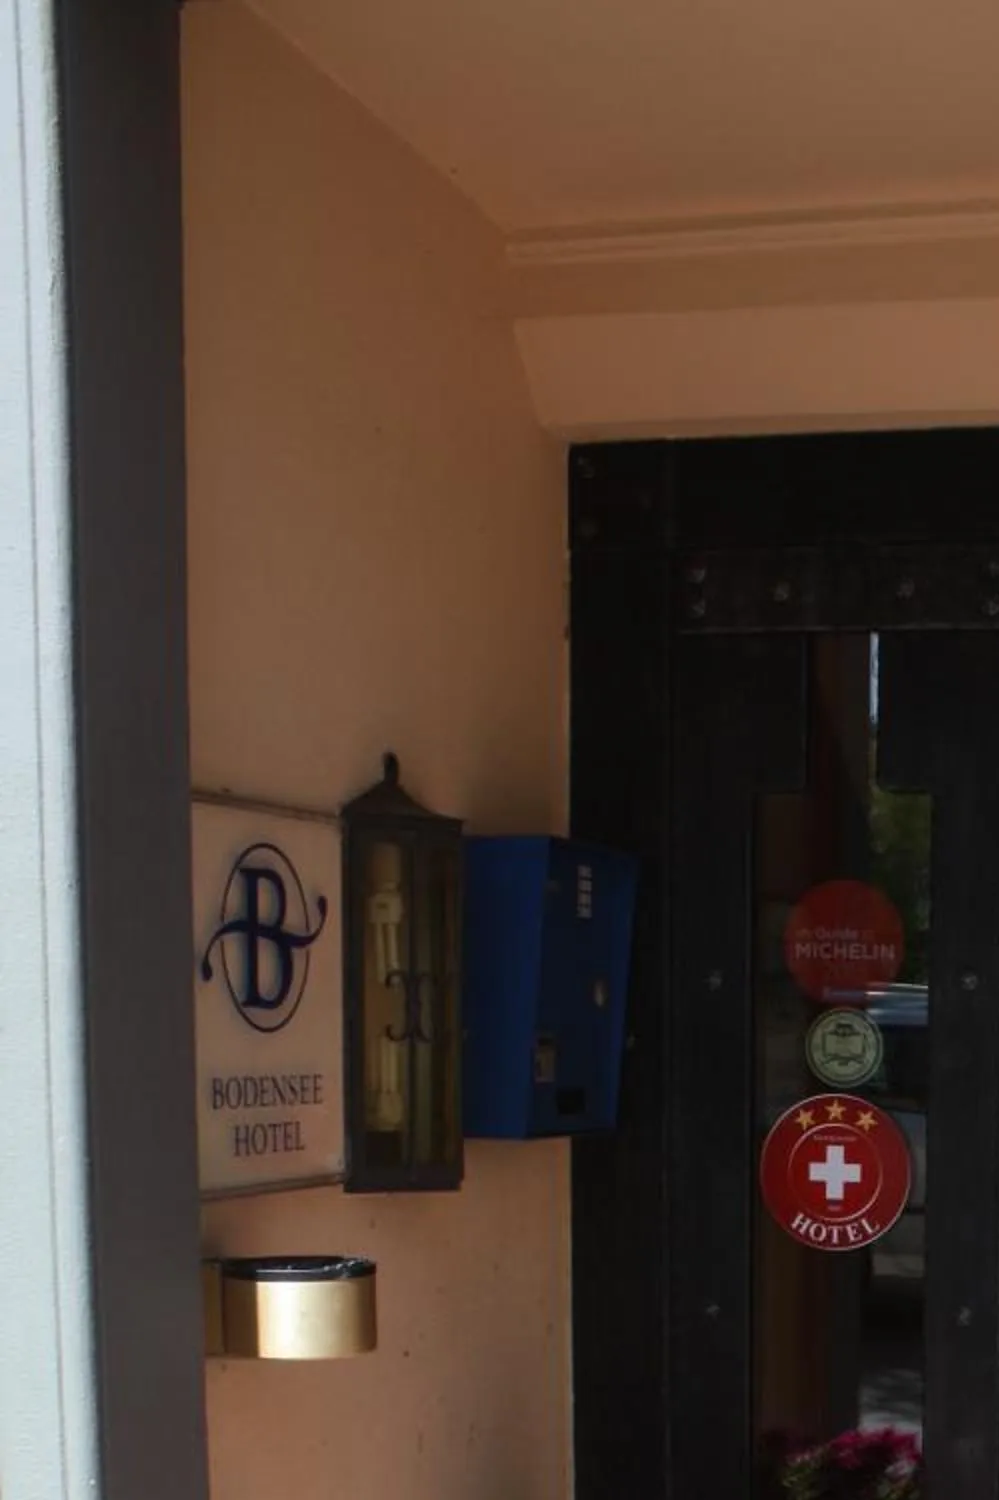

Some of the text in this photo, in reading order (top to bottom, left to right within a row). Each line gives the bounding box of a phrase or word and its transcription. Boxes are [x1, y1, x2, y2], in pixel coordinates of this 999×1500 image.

[794, 941, 896, 961] MICHELIN
[211, 1073, 324, 1110] BODENSEE
[233, 1121, 305, 1156] HOTEL
[791, 1211, 880, 1244] HOTEL
